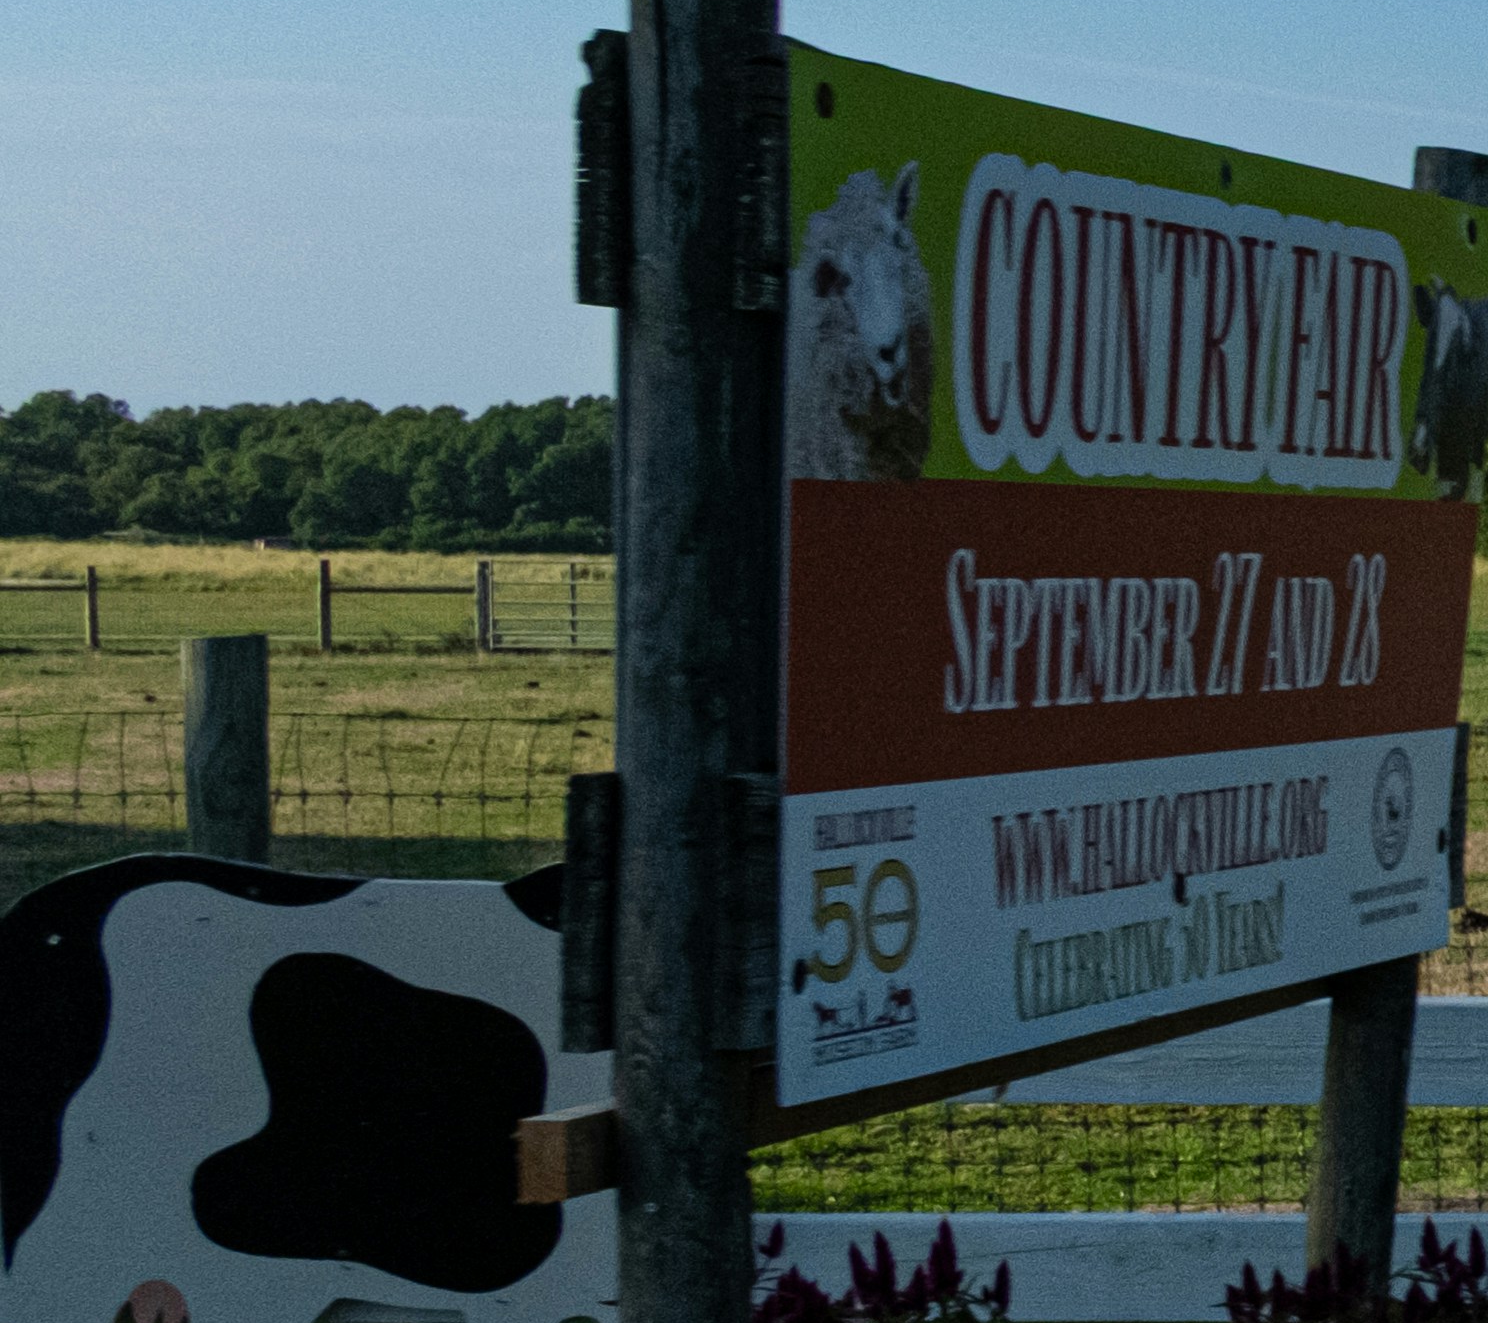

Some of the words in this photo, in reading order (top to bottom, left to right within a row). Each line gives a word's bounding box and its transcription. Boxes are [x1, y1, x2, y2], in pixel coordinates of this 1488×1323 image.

[970, 188, 1276, 452] COUNTRY
[1280, 245, 1399, 460] FAIR
[944, 548, 1200, 713] SEPTEMBER
[1206, 551, 1264, 695] 27
[1260, 577, 1335, 691] AND
[1339, 553, 1387, 687] 28
[992, 775, 1329, 910] WWW.HALLOCKVILLE.ORG
[808, 858, 920, 984] 50
[1013, 927, 1175, 1022] CELEBRATING
